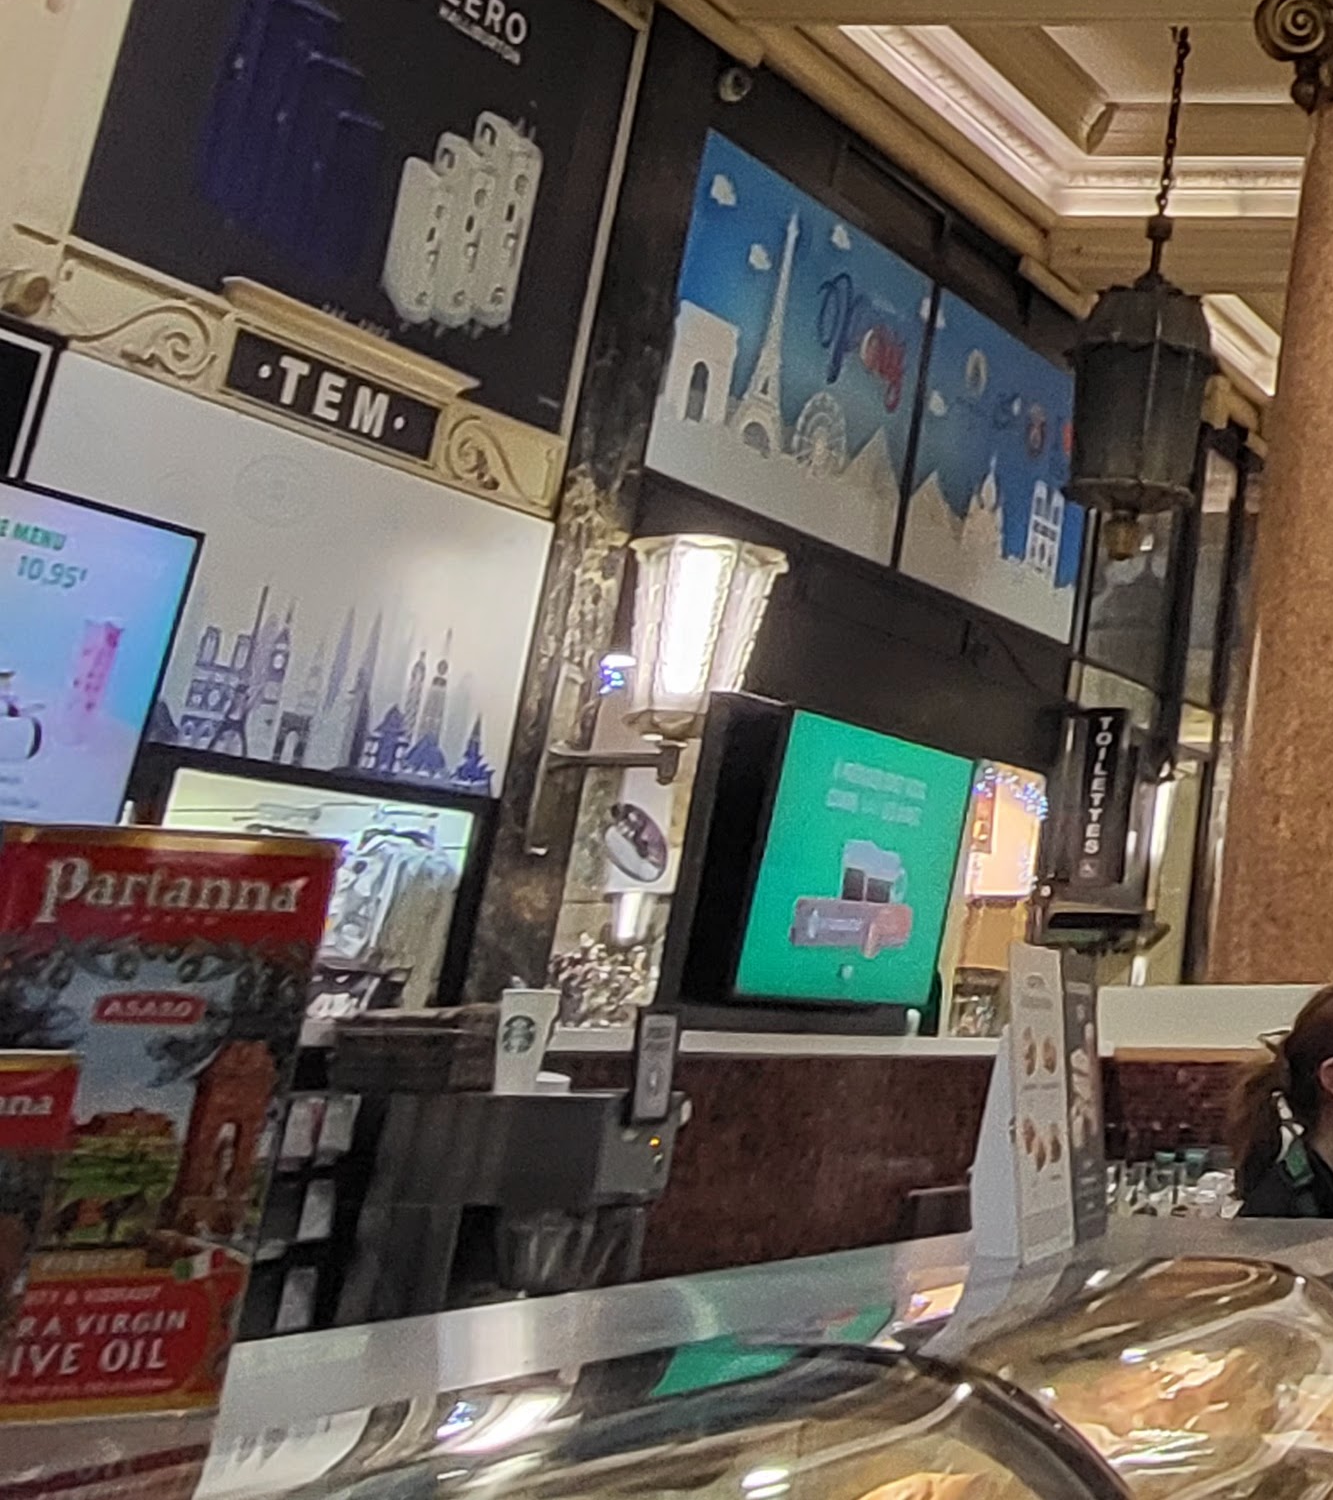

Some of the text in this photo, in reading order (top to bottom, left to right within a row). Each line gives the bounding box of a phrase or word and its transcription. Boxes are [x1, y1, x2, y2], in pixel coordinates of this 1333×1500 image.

[279, 355, 390, 438] TEM
[12, 522, 67, 551] MENU
[1083, 715, 1114, 854] TOILETTES
[34, 856, 309, 924] Partanna
[75, 1310, 188, 1335] VIRGIN
[8, 1337, 167, 1379] IVE OIL
